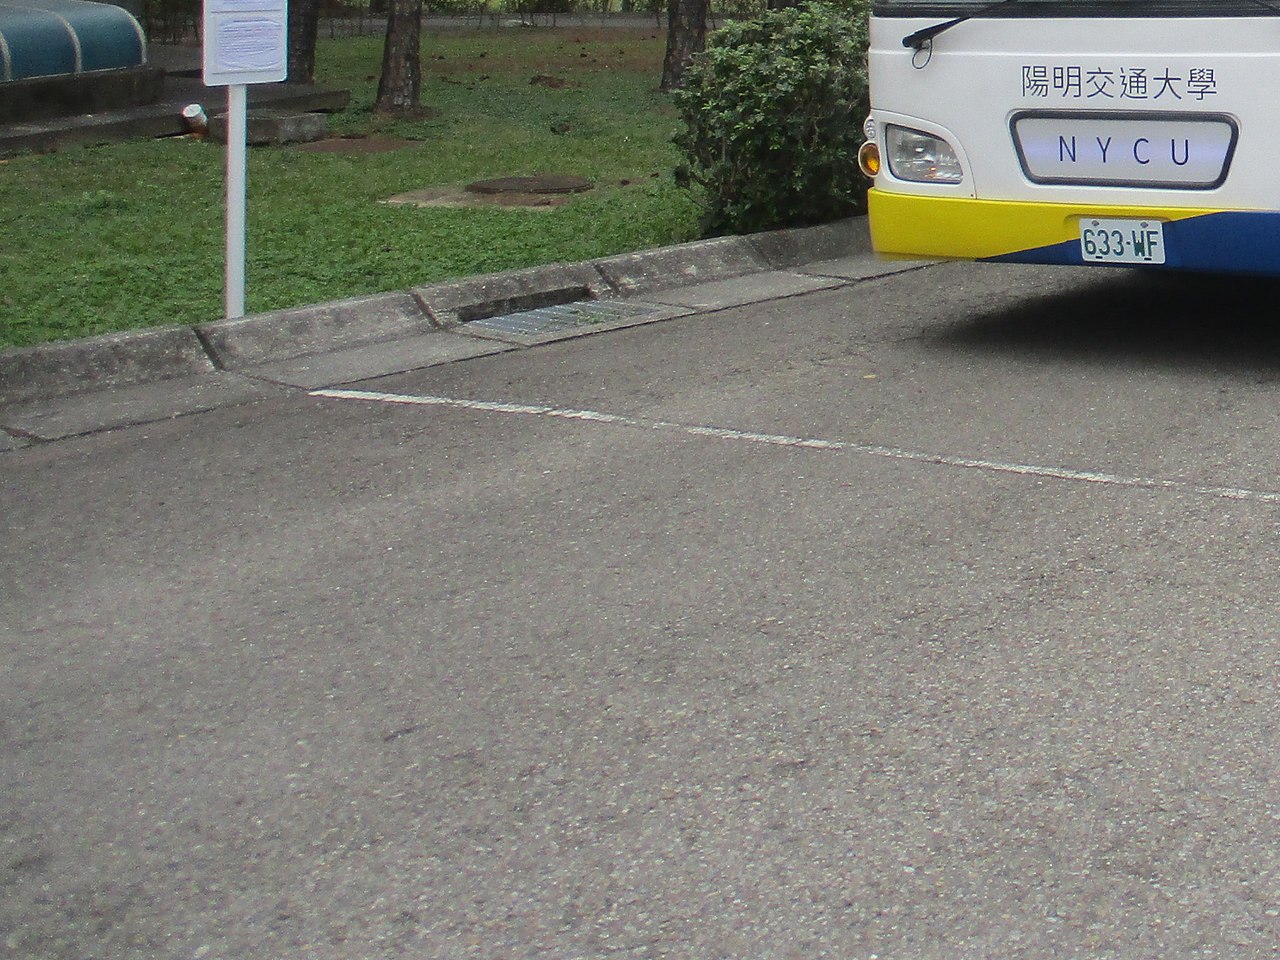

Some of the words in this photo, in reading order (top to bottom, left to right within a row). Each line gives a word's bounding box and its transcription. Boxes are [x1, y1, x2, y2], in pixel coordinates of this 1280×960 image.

[1021, 65, 1218, 101] 陽明交通大學
[1083, 228, 1159, 257] 633-WF
